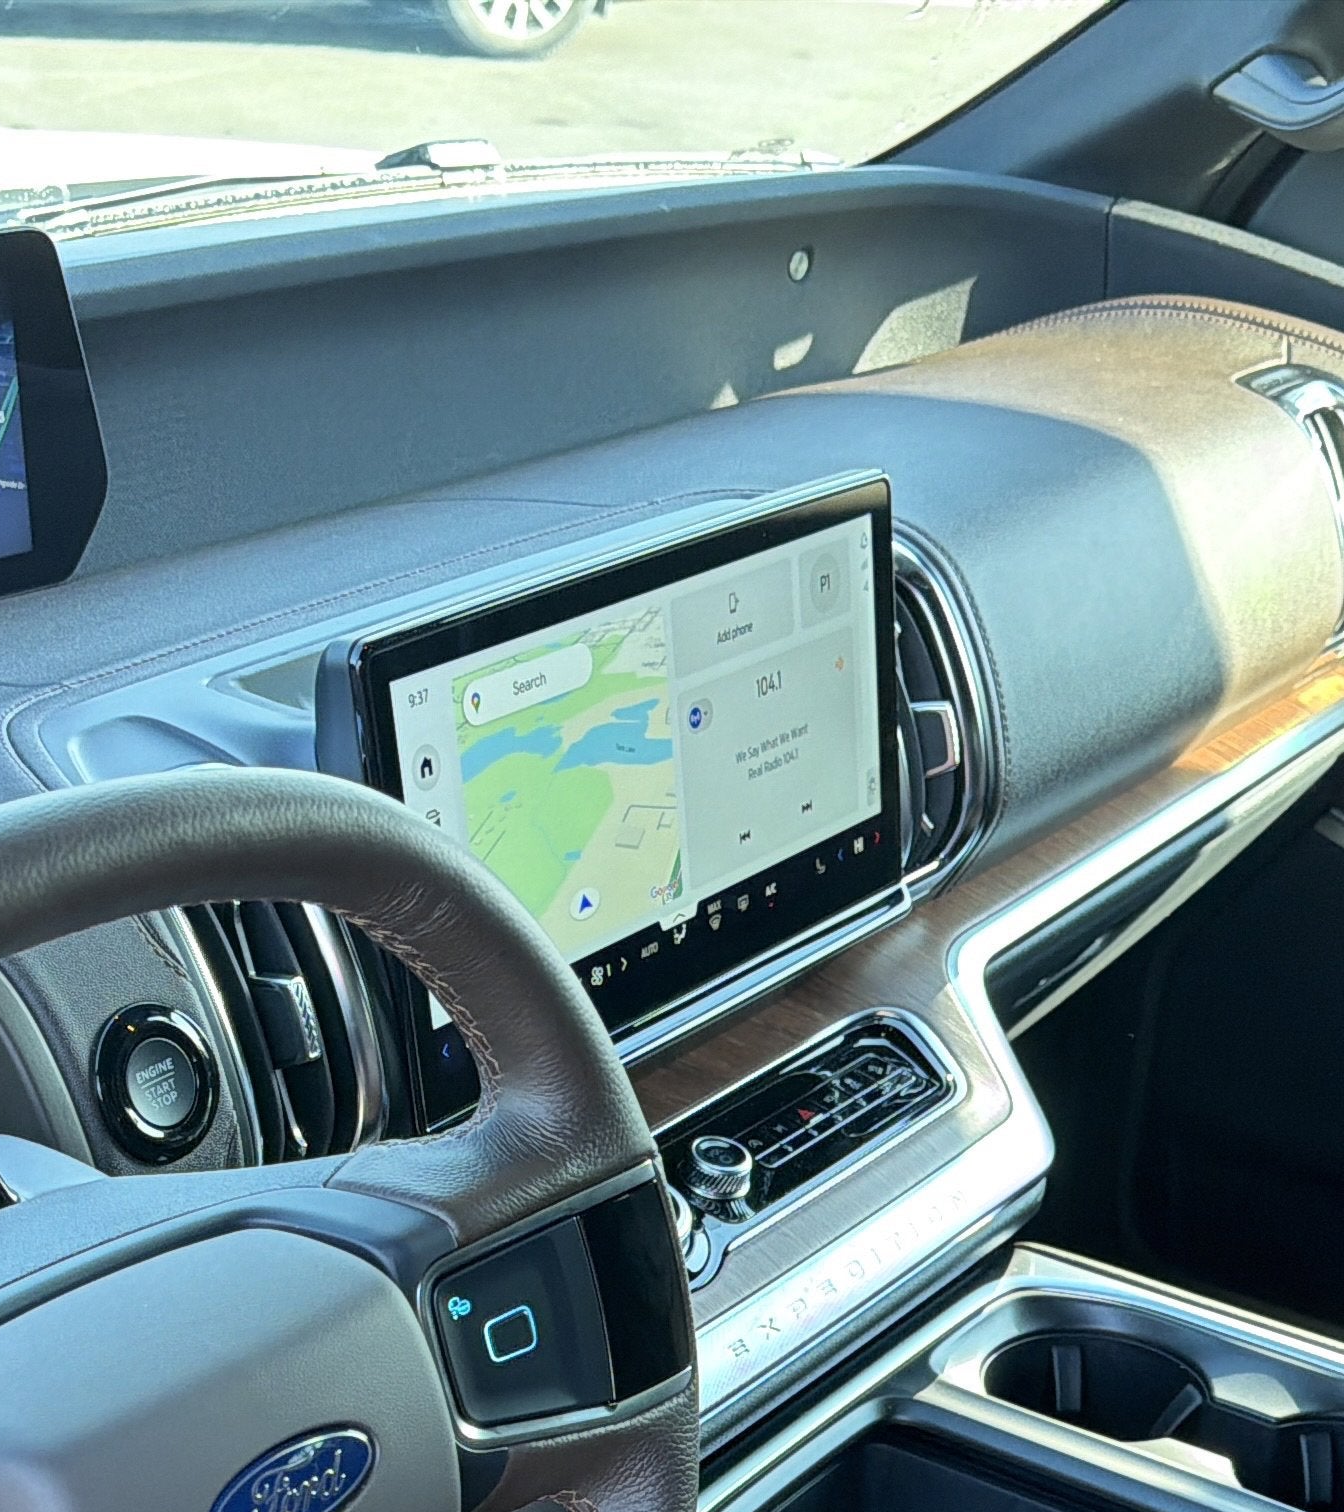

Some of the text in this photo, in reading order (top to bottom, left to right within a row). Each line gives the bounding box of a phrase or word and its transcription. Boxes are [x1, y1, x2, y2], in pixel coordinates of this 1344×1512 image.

[716, 627, 731, 646] Add
[511, 671, 547, 697] Search
[755, 669, 783, 699] 104.1
[408, 688, 429, 709] 9:37
[640, 941, 659, 960] AUTO
[135, 1057, 175, 1084] ENGINE
[144, 1077, 176, 1101] START
[151, 1090, 178, 1110] STOP
